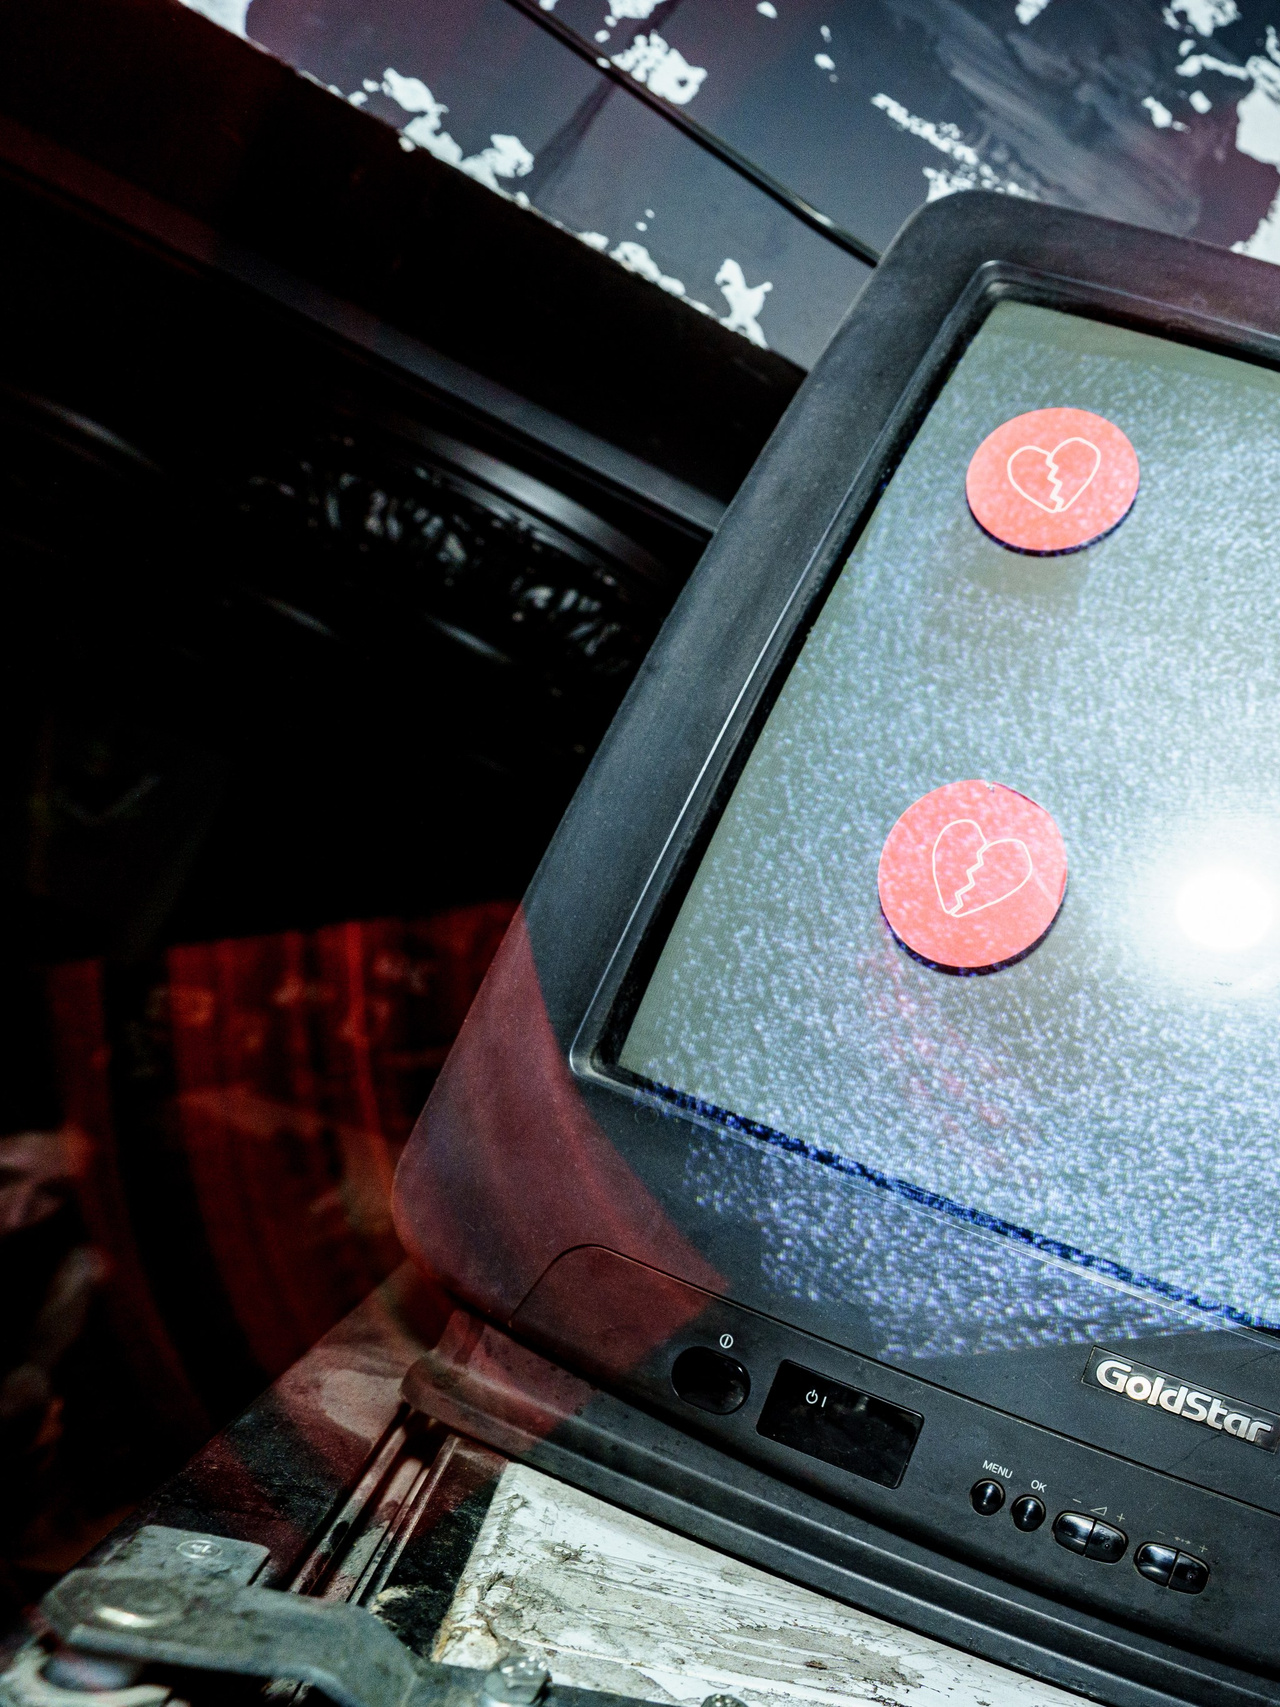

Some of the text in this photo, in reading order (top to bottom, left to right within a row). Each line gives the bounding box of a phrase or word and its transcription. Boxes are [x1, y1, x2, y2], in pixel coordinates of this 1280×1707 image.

[1096, 1360, 1272, 1442] GoldStar
[982, 1459, 1013, 1479] MENU
[1030, 1479, 1047, 1493] OK
